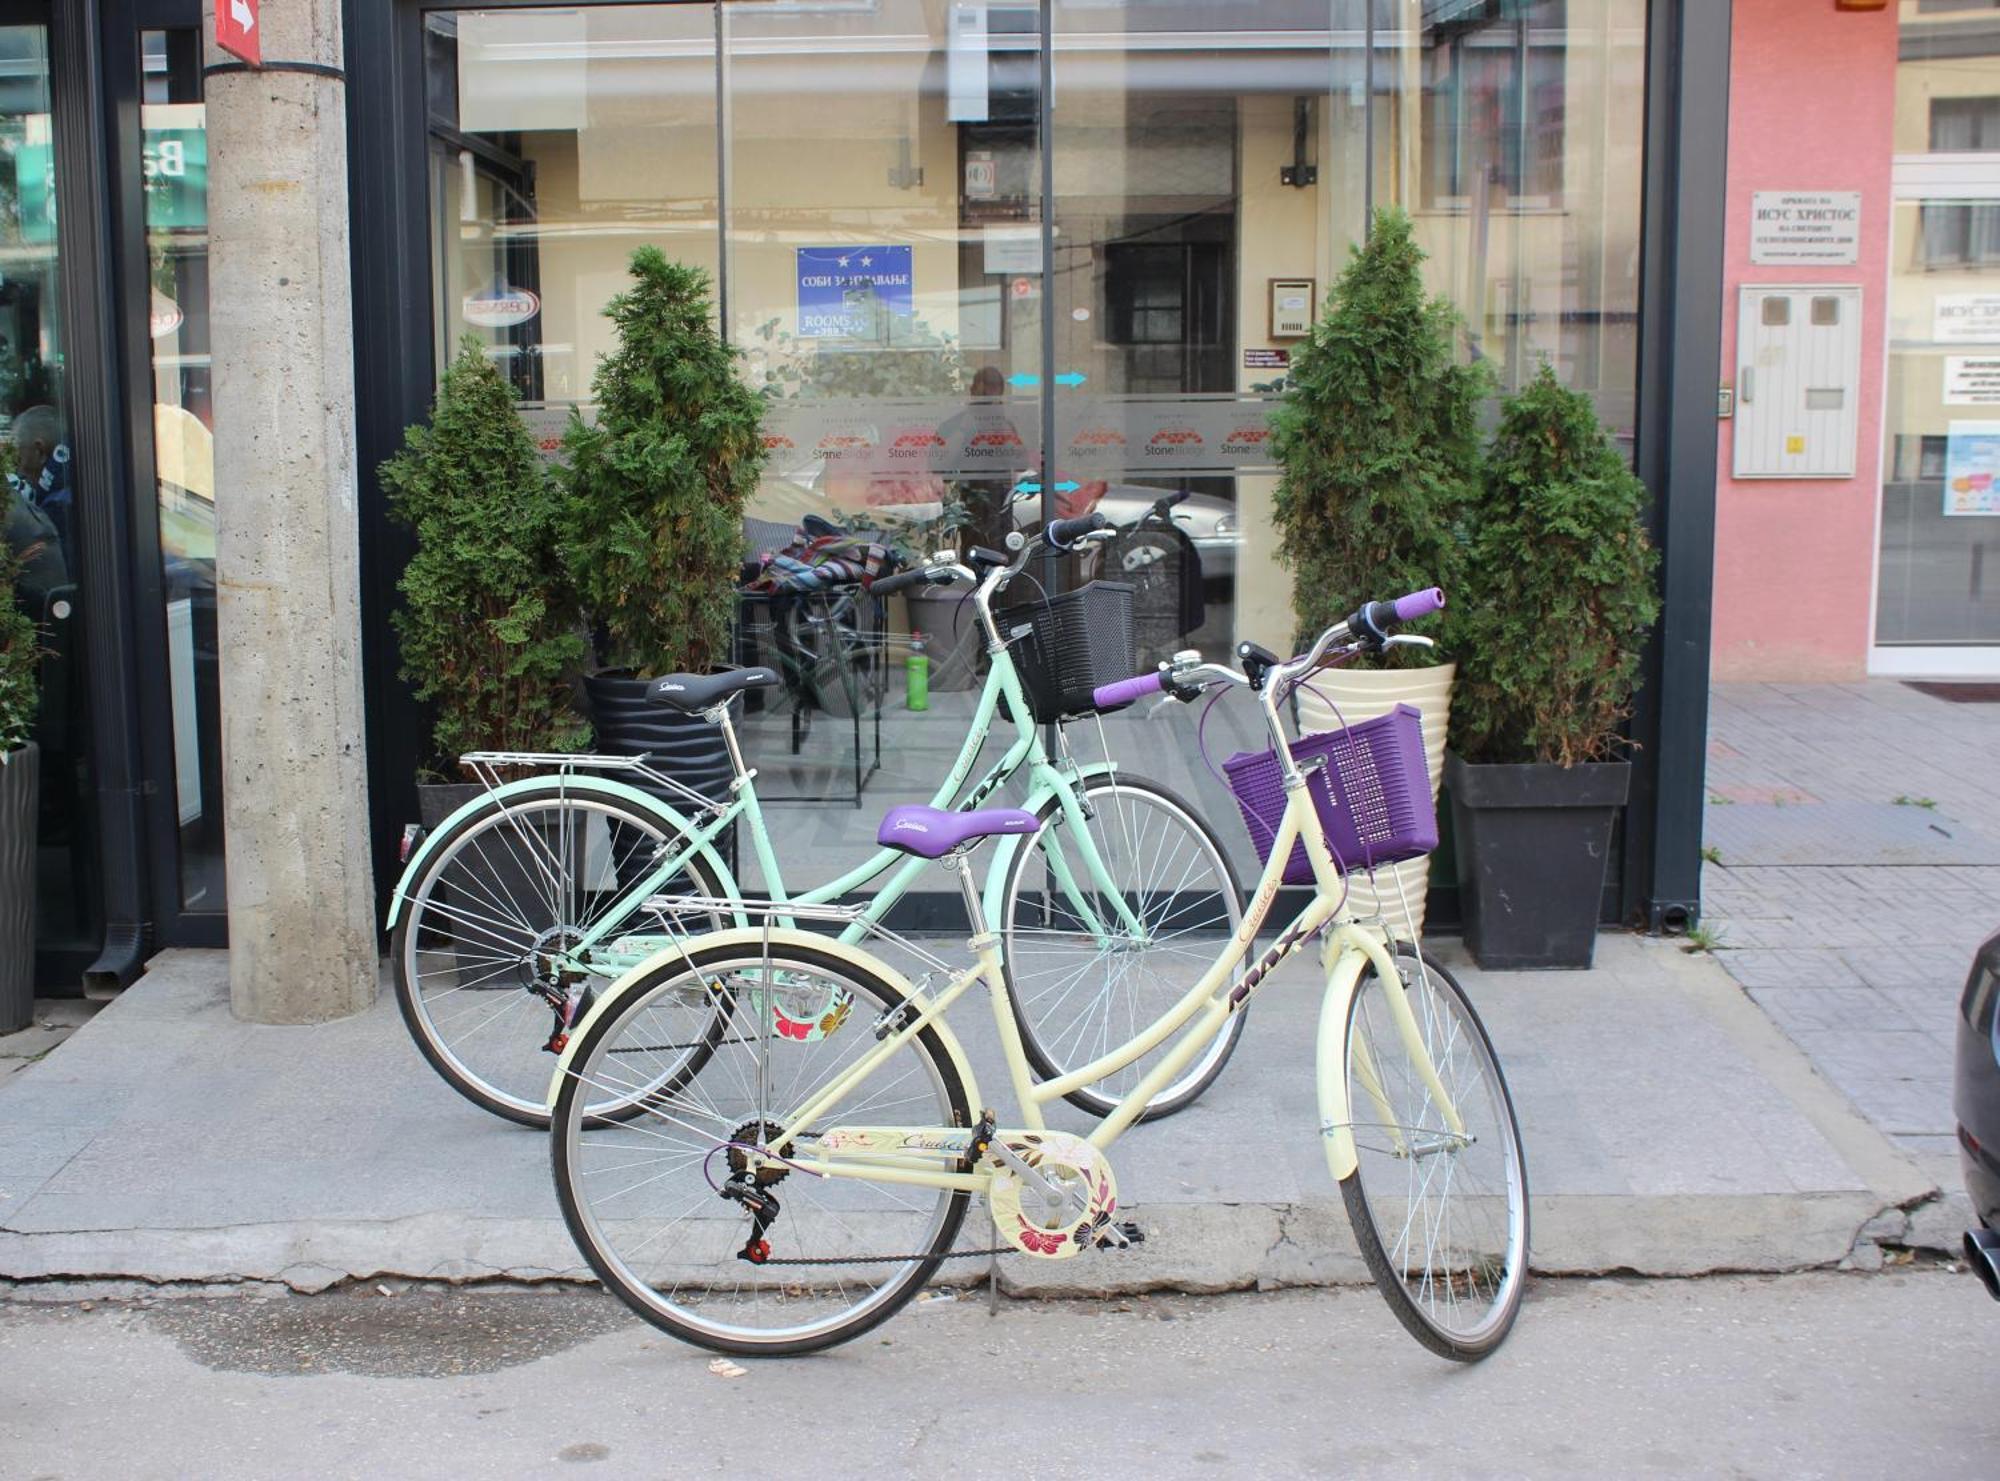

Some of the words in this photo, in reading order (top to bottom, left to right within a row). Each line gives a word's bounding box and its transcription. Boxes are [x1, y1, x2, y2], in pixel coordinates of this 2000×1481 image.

[1757, 208, 1791, 221] ИСУС
[1796, 208, 1856, 221] ХРИСТОС
[801, 275, 832, 288] СОБИ
